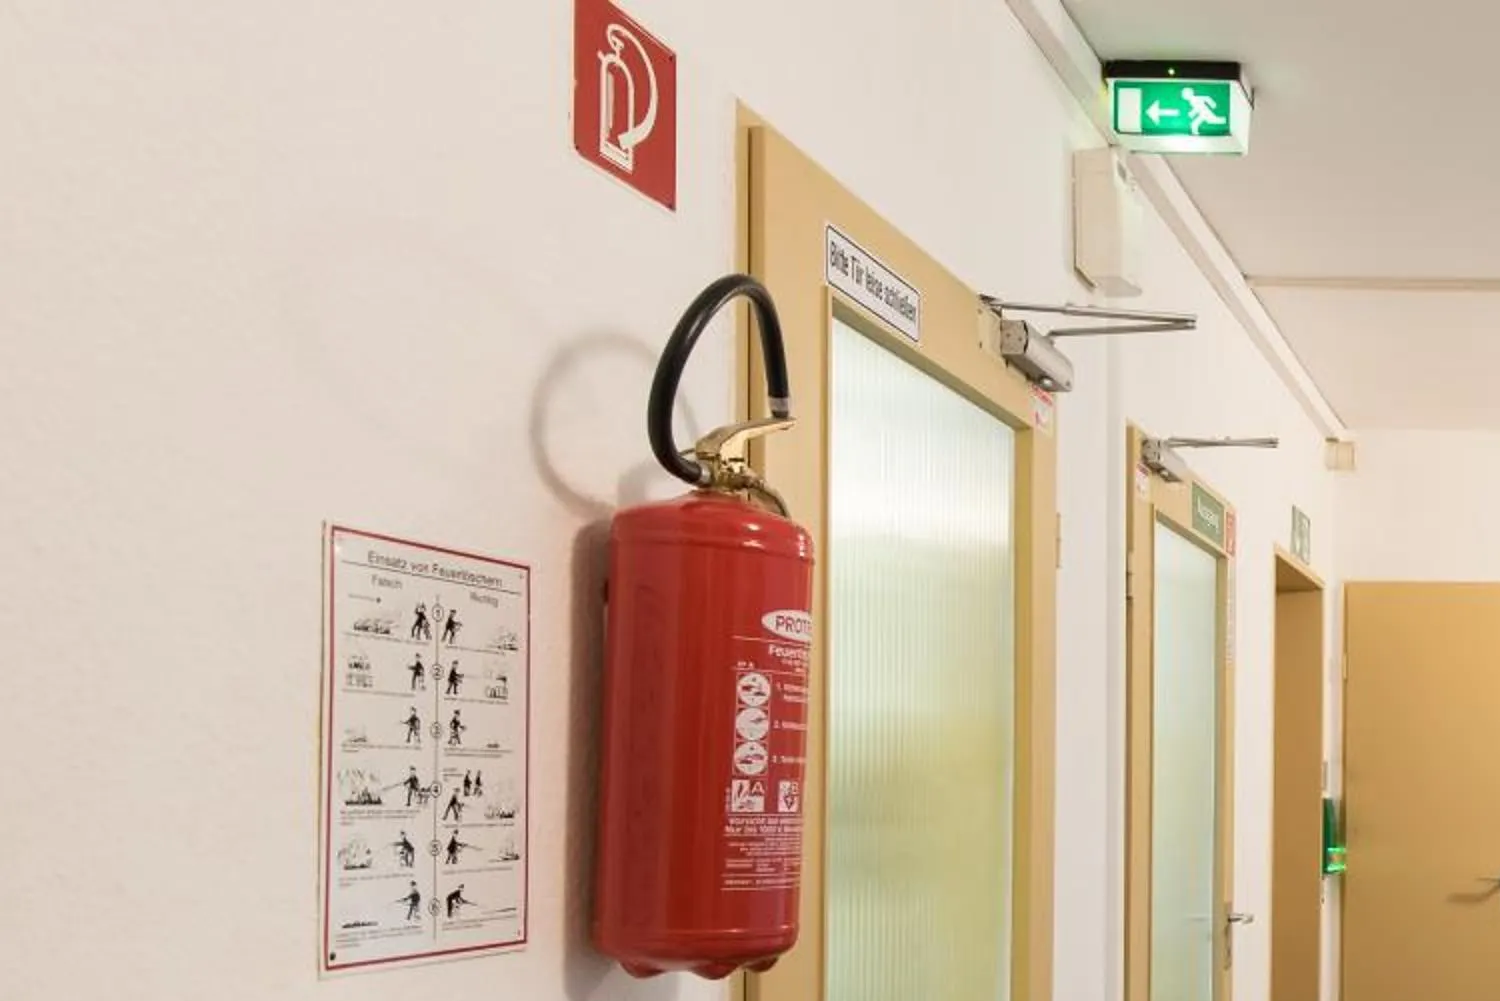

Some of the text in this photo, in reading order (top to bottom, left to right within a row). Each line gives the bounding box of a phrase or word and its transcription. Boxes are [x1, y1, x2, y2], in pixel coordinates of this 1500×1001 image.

[830, 240, 849, 277] Bitte
[851, 255, 865, 286] Tür
[368, 550, 406, 569] Einsatz
[411, 563, 429, 574] von
